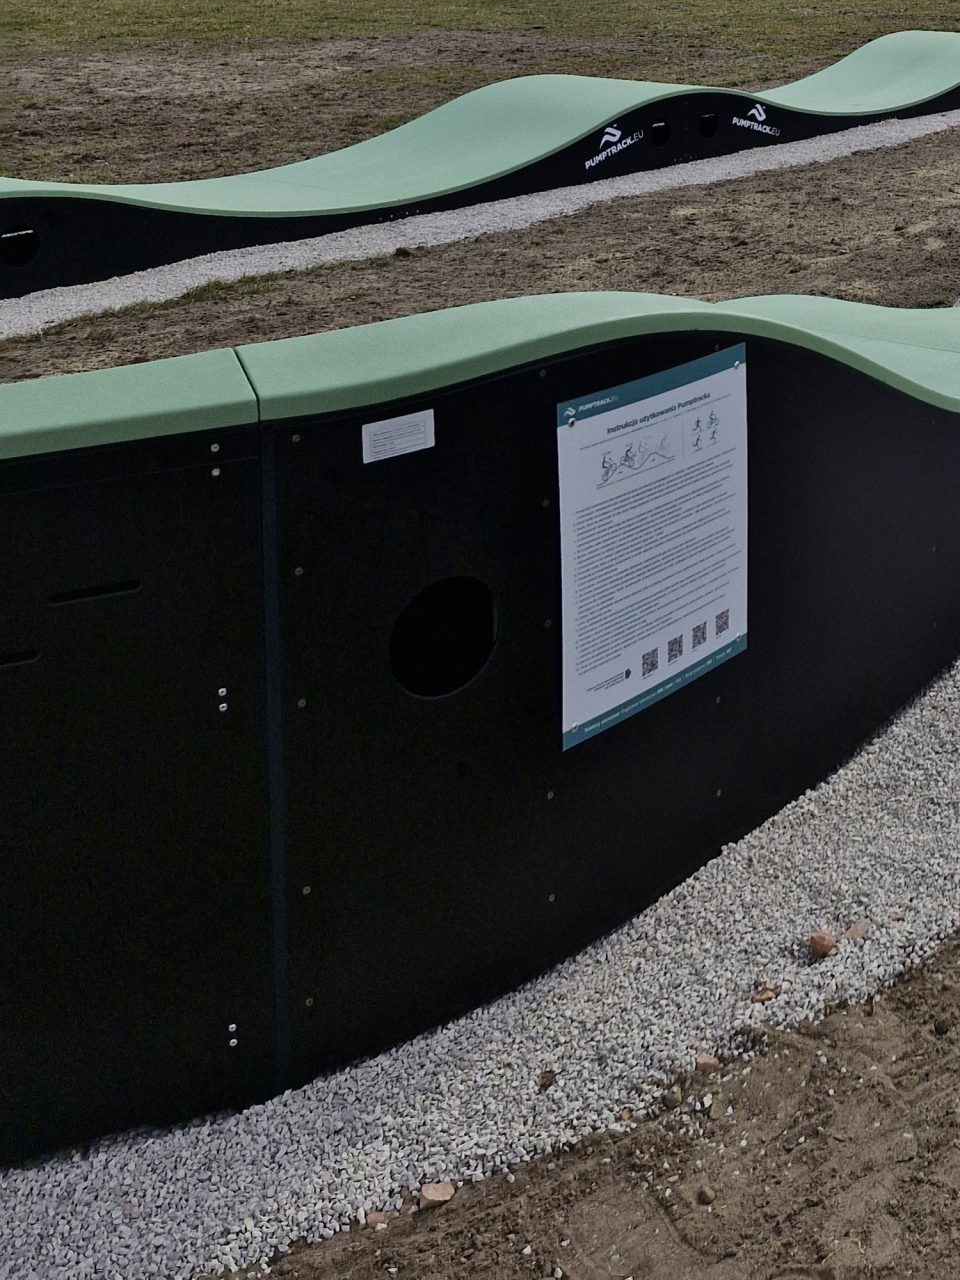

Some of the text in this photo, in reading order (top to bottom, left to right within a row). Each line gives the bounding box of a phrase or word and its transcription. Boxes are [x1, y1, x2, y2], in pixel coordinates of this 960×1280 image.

[732, 116, 781, 137] PUMPTRACK.EU
[584, 129, 644, 170] PUMPTRACK.EU
[606, 417, 638, 435] Instrukcja
[639, 404, 677, 425] użytkowania
[677, 393, 711, 411] Pumptracku
